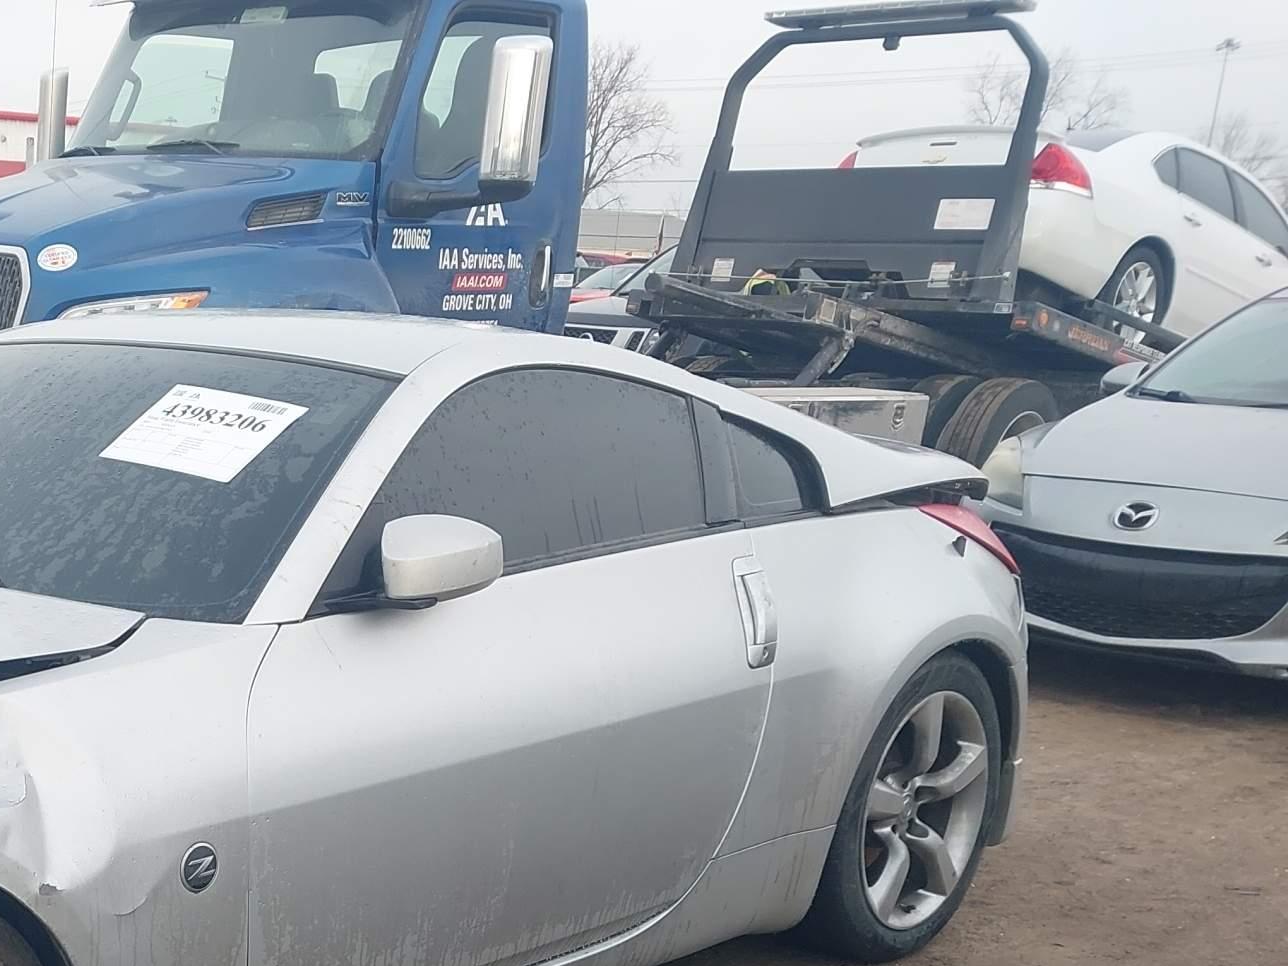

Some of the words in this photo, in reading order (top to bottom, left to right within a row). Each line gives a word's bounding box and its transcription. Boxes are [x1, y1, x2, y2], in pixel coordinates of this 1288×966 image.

[336, 191, 369, 203] MV
[391, 228, 431, 250] 22100662
[438, 248, 459, 270] IAA
[461, 248, 506, 272] Services,
[507, 248, 524, 271] Inc.
[456, 275, 504, 288] IAAI.COM
[442, 295, 475, 311] GROVE
[475, 295, 497, 312] CITY,
[498, 294, 513, 310] OH
[162, 402, 272, 433] 43983206
